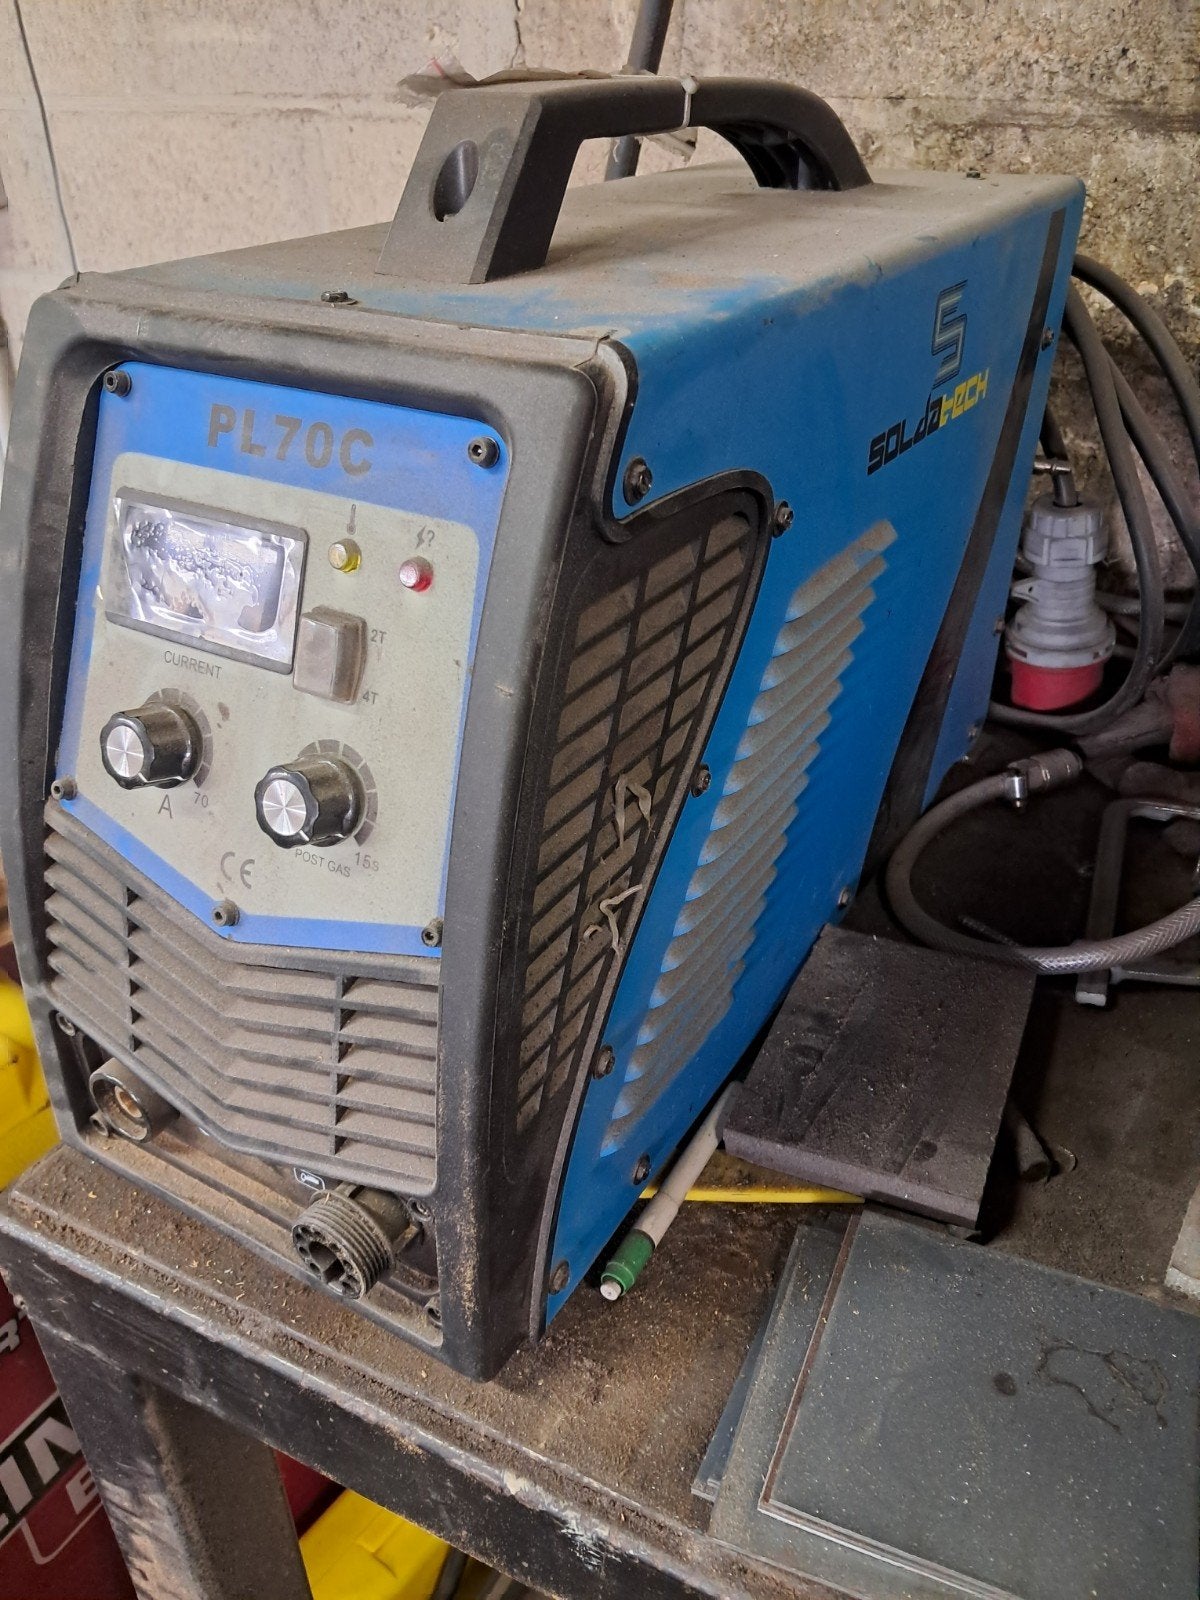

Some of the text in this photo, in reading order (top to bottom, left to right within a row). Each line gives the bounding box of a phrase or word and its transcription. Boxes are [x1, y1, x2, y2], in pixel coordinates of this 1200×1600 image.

[206, 402, 375, 477] PL70C
[370, 628, 387, 644] 2T
[163, 649, 223, 680] CURRENT
[361, 690, 378, 705] 4T
[157, 794, 173, 820] A
[193, 791, 209, 809] 70
[220, 851, 256, 890] CE
[294, 848, 351, 878] POST GAS
